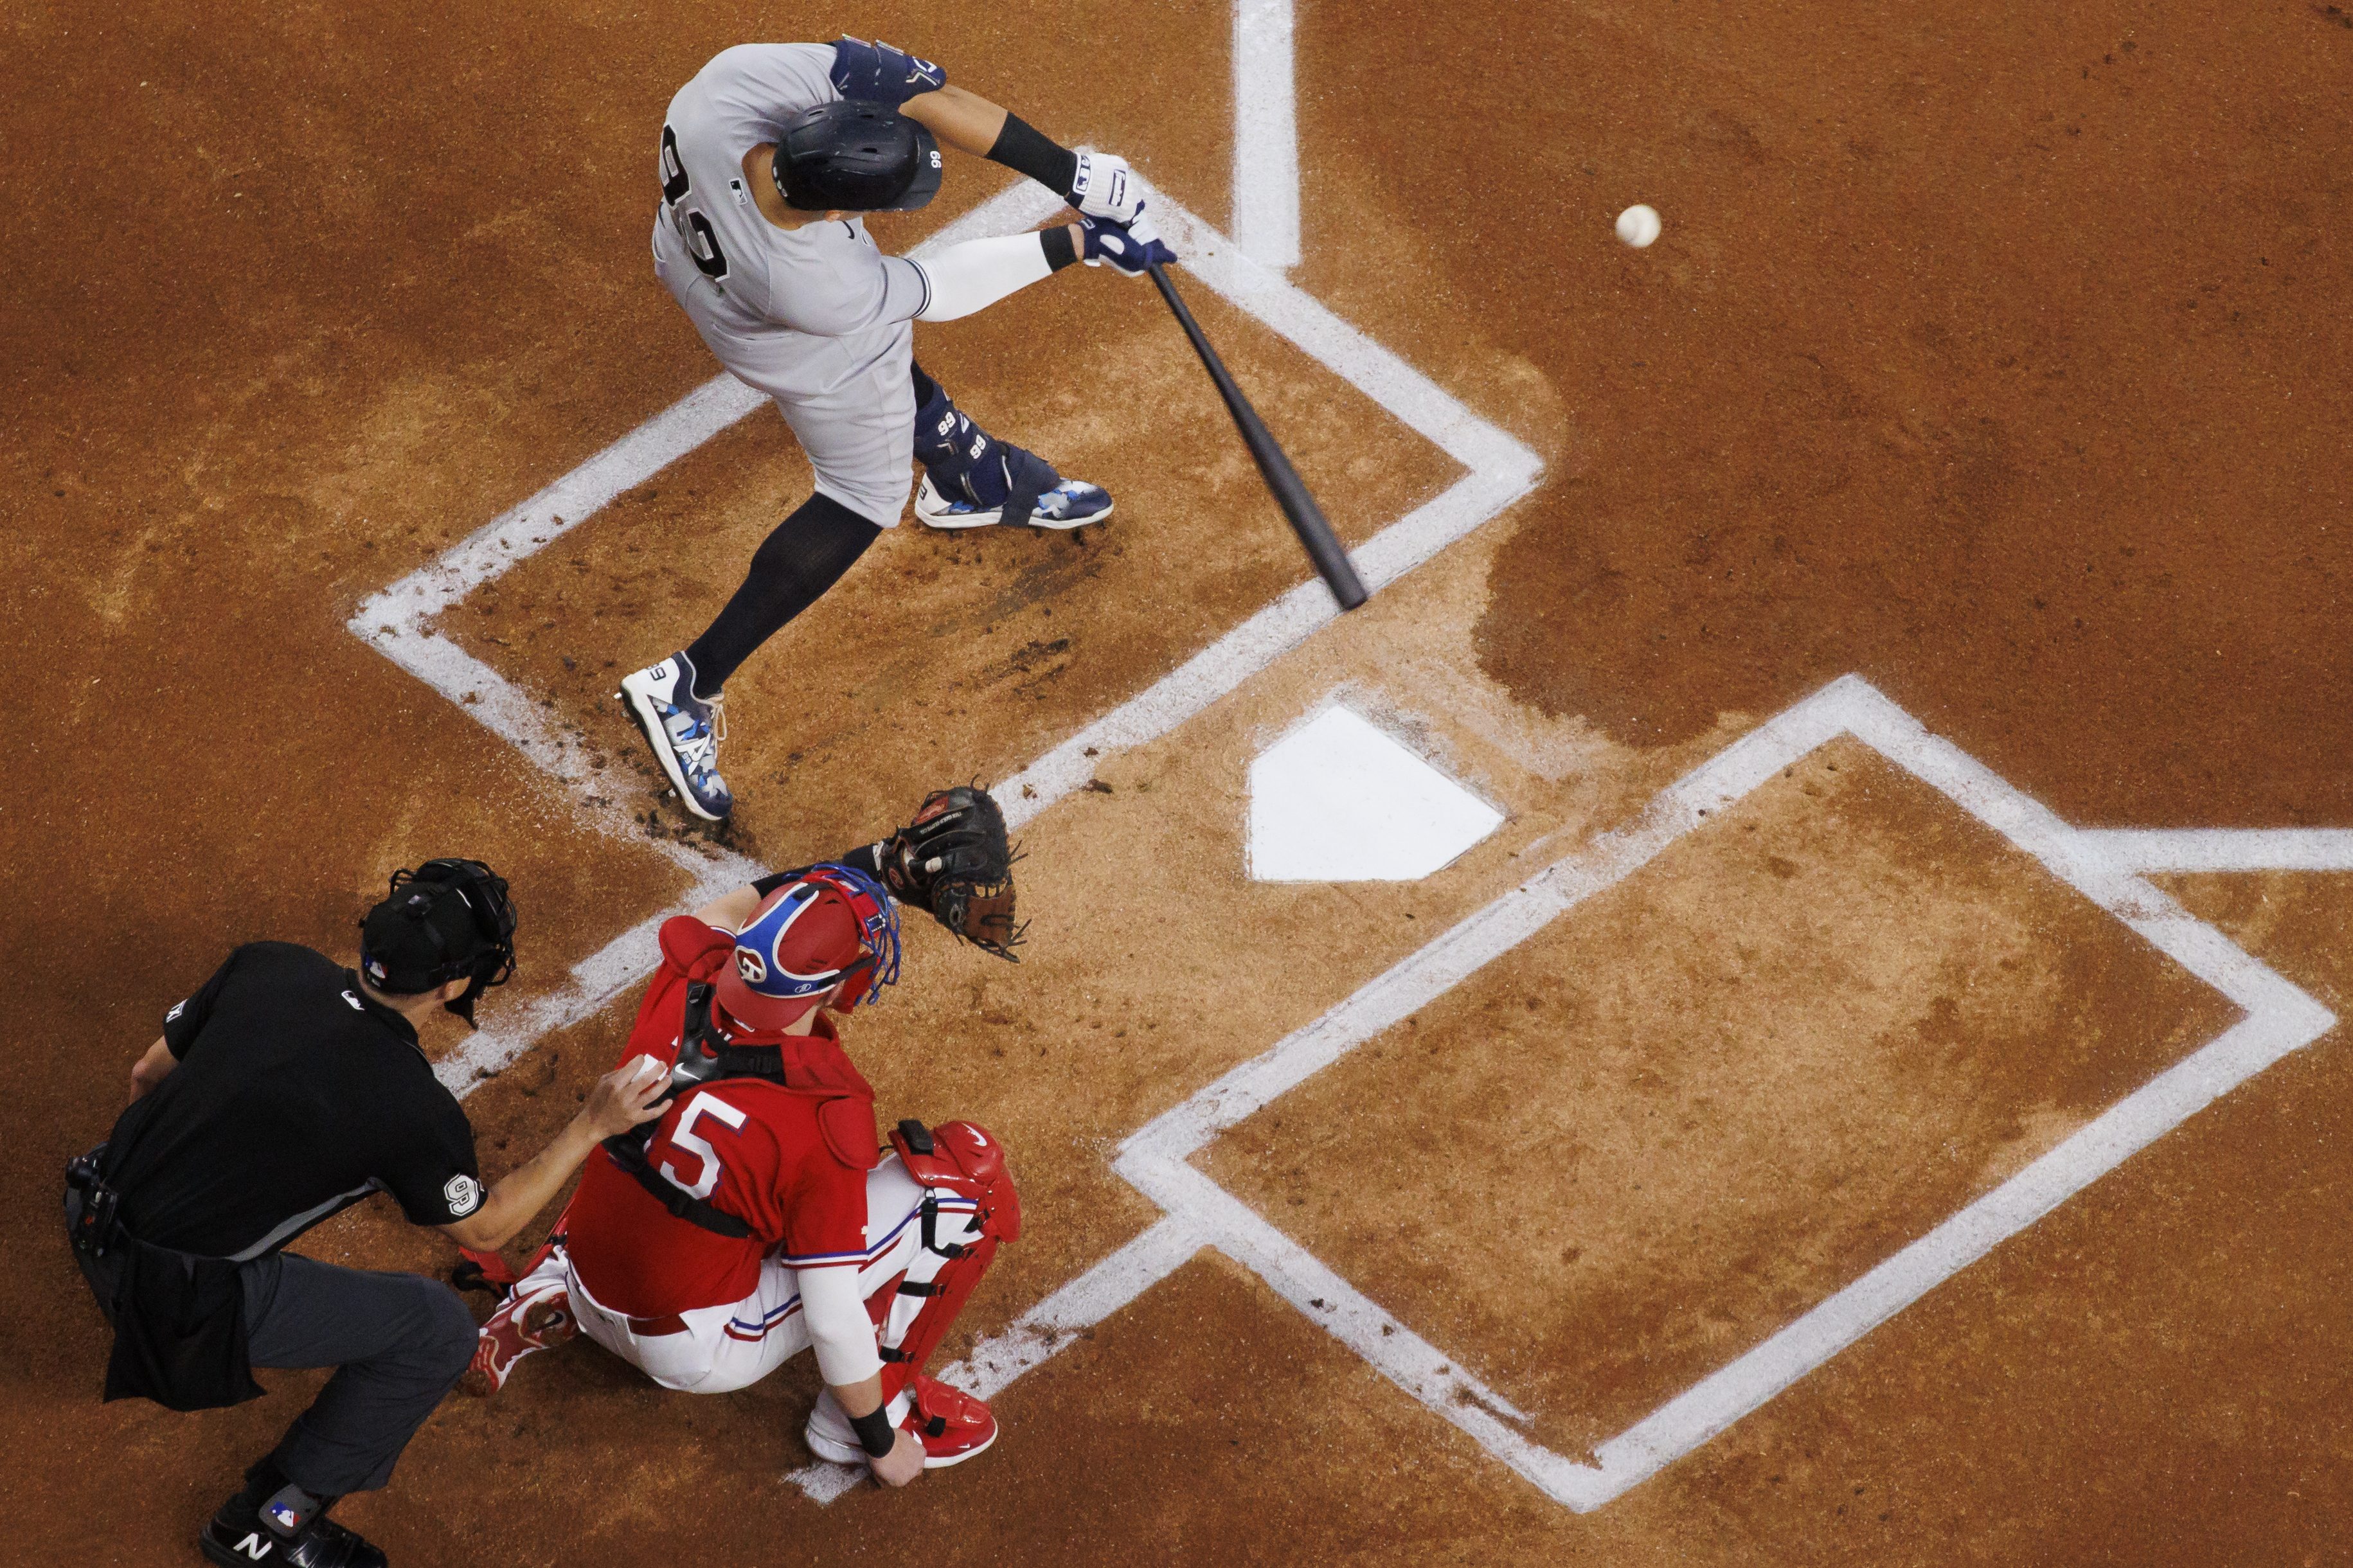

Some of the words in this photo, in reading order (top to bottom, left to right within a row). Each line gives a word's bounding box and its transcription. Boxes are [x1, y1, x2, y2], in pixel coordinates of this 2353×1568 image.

[938, 411, 956, 436] 99
[969, 434, 987, 459] 99
[643, 1091, 751, 1202] 5
[233, 1533, 272, 1561] N
